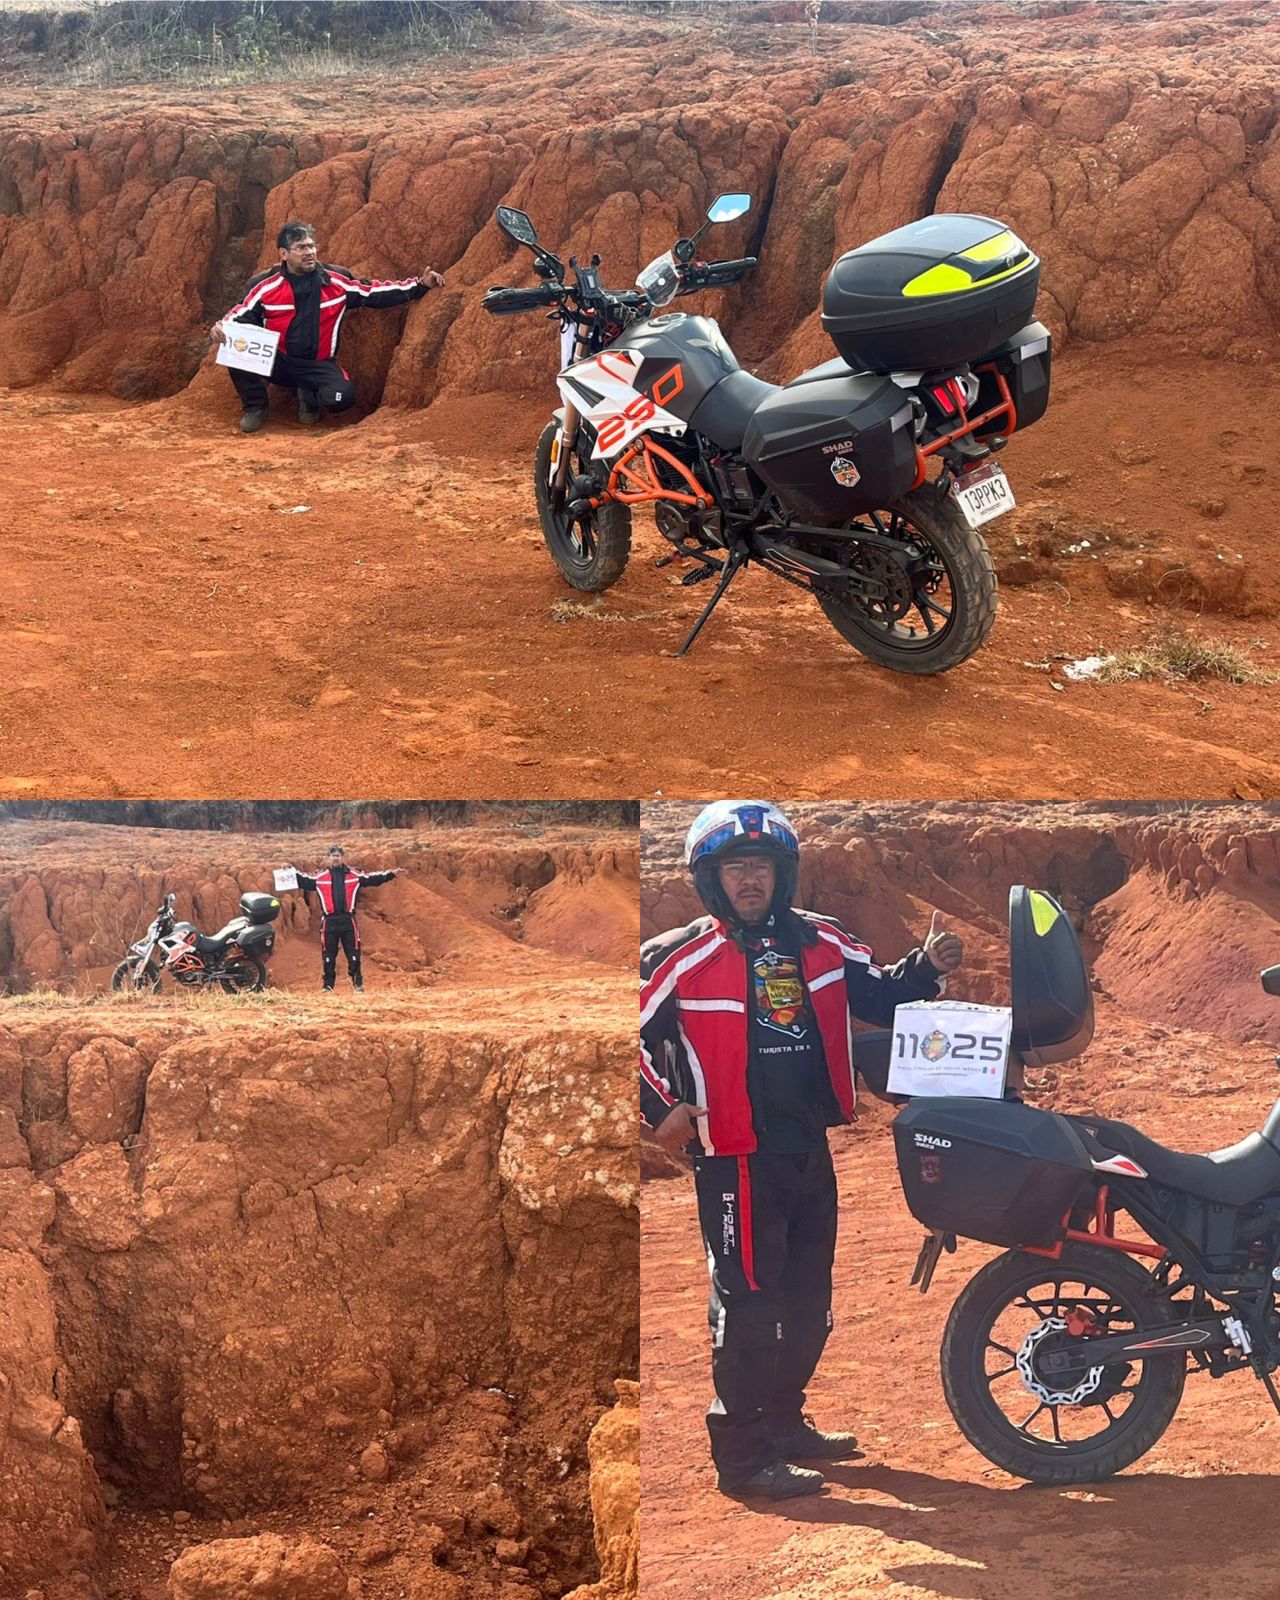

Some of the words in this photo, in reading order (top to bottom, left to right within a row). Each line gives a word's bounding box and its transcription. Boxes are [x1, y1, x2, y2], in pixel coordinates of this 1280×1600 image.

[821, 440, 854, 455] SHAD
[964, 478, 1007, 513] 13PPK3
[758, 1046, 793, 1054] TURISTA
[913, 1132, 952, 1149] SHAD
